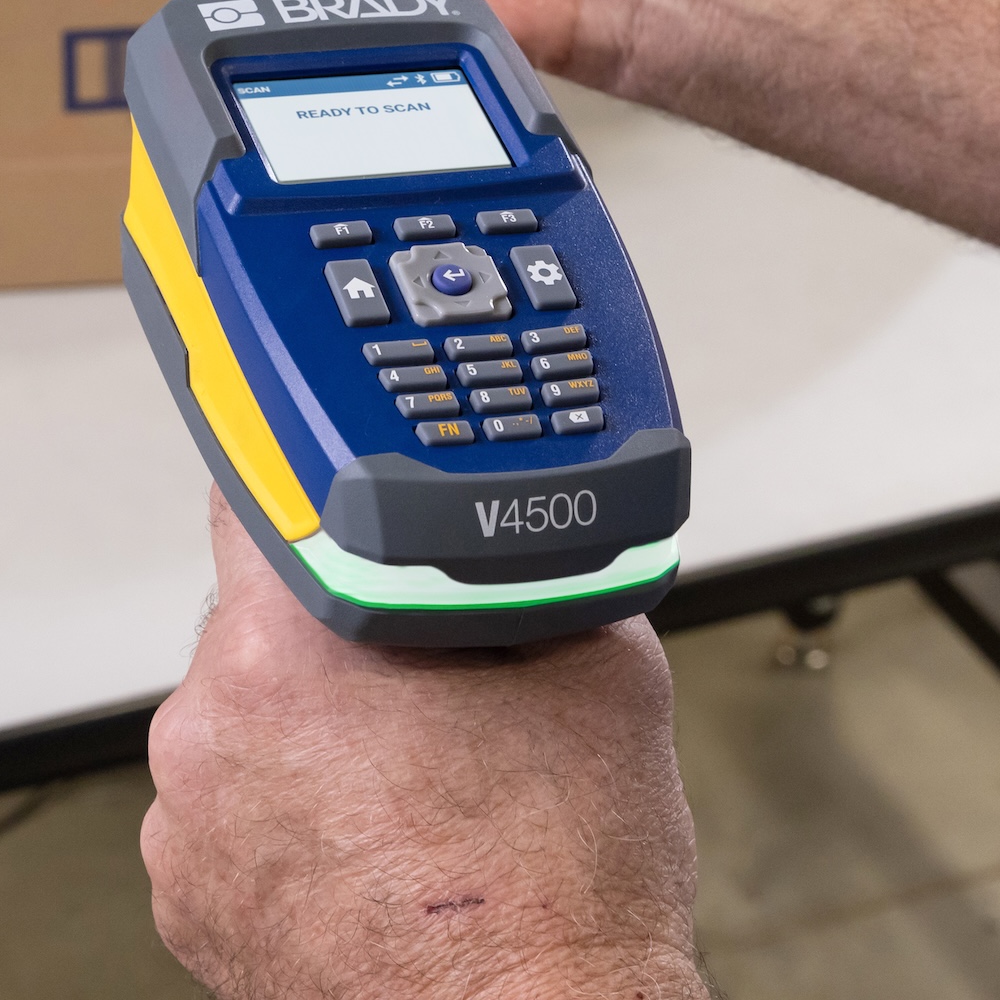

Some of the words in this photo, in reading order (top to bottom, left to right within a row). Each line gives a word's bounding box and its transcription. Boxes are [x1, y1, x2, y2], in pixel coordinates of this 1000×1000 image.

[237, 86, 270, 95] SCAN
[296, 107, 352, 119] READY
[355, 105, 380, 115] TO
[384, 102, 431, 113] SCAN
[419, 220, 435, 229] F2
[501, 214, 517, 223] F3
[335, 226, 350, 235] F1
[453, 338, 465, 350] 2
[489, 335, 507, 344] ABC
[529, 332, 540, 343] 3
[563, 326, 580, 335] DEF
[372, 344, 382, 356] 1
[466, 364, 477, 376] 5
[500, 360, 517, 369] JKL
[539, 358, 551, 370] 6
[567, 353, 588, 362] MNO
[389, 370, 400, 382] 4
[424, 366, 441, 375] GHI
[479, 391, 490, 403] 8
[508, 387, 526, 396] TUV
[550, 384, 561, 397] 9
[568, 379, 594, 389] WXYZ
[405, 397, 416, 409] 7
[428, 393, 453, 403] PQRS
[437, 422, 460, 437] FN
[493, 419, 504, 432] 0
[475, 489, 597, 538] V4500
